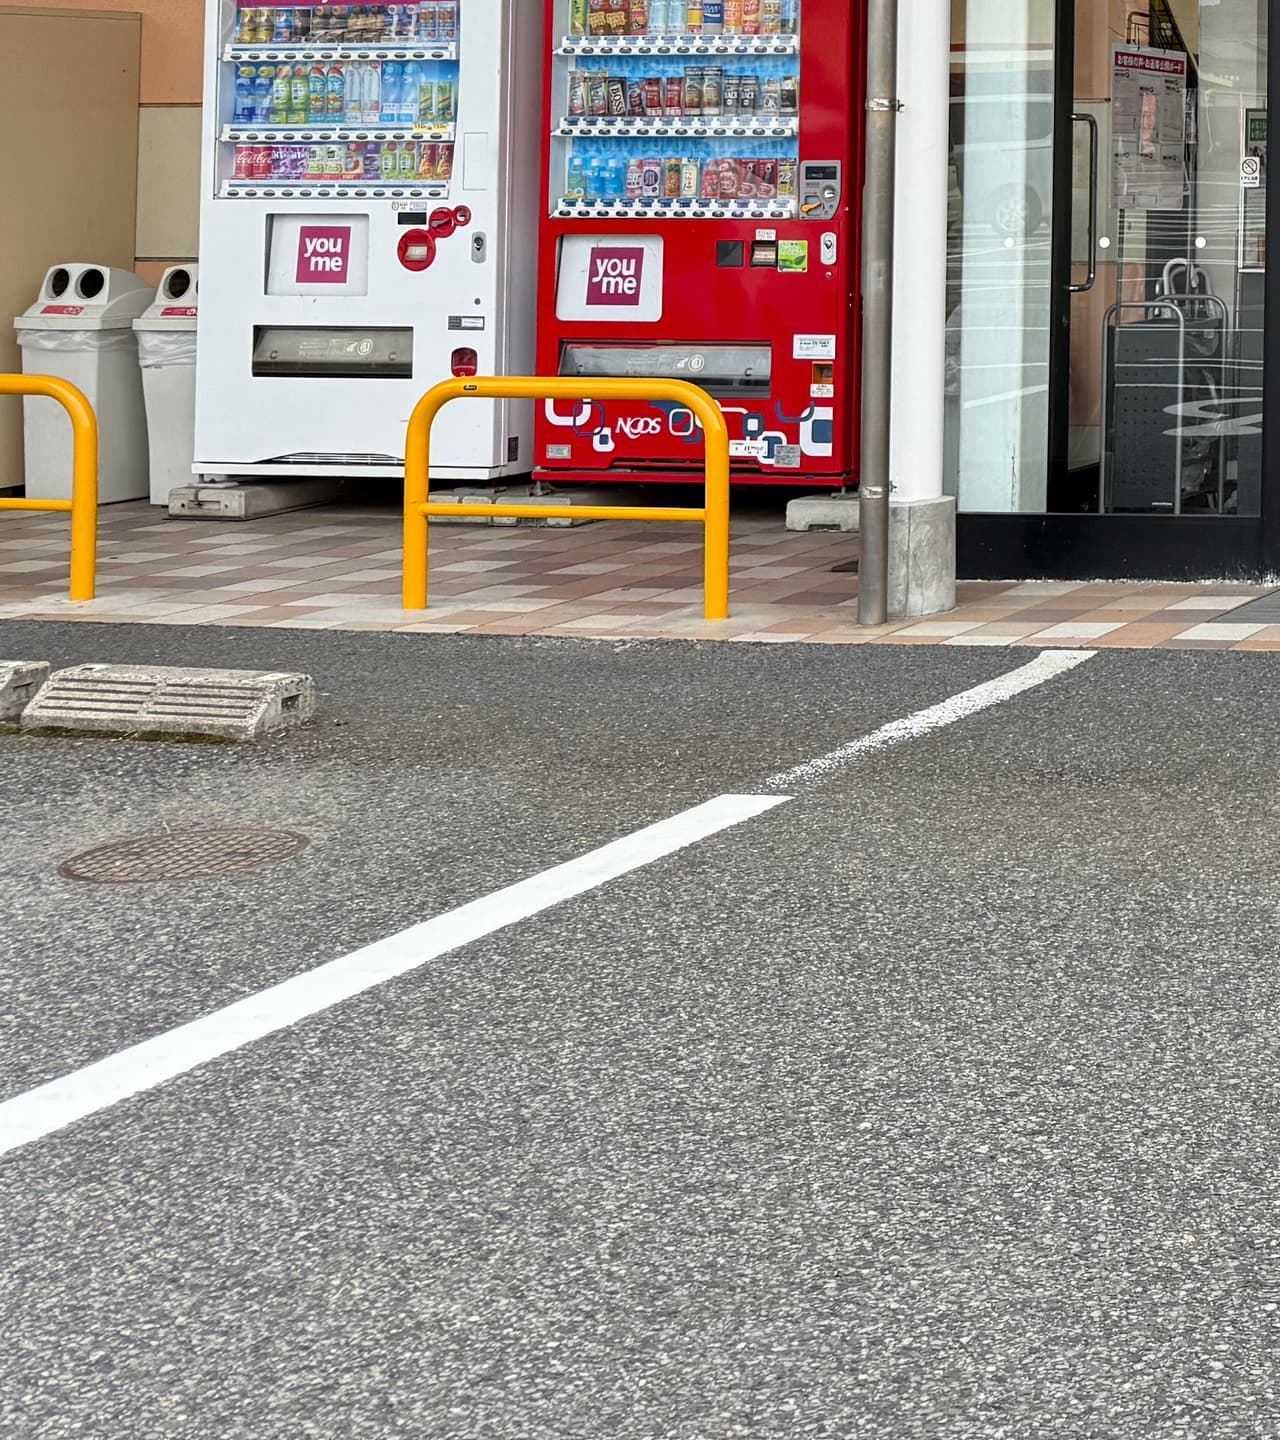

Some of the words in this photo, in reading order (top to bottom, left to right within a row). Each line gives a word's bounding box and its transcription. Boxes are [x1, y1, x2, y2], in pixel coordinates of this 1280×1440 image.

[304, 237, 342, 257] you
[310, 256, 343, 271] me
[592, 258, 636, 282] you
[601, 276, 637, 294] me
